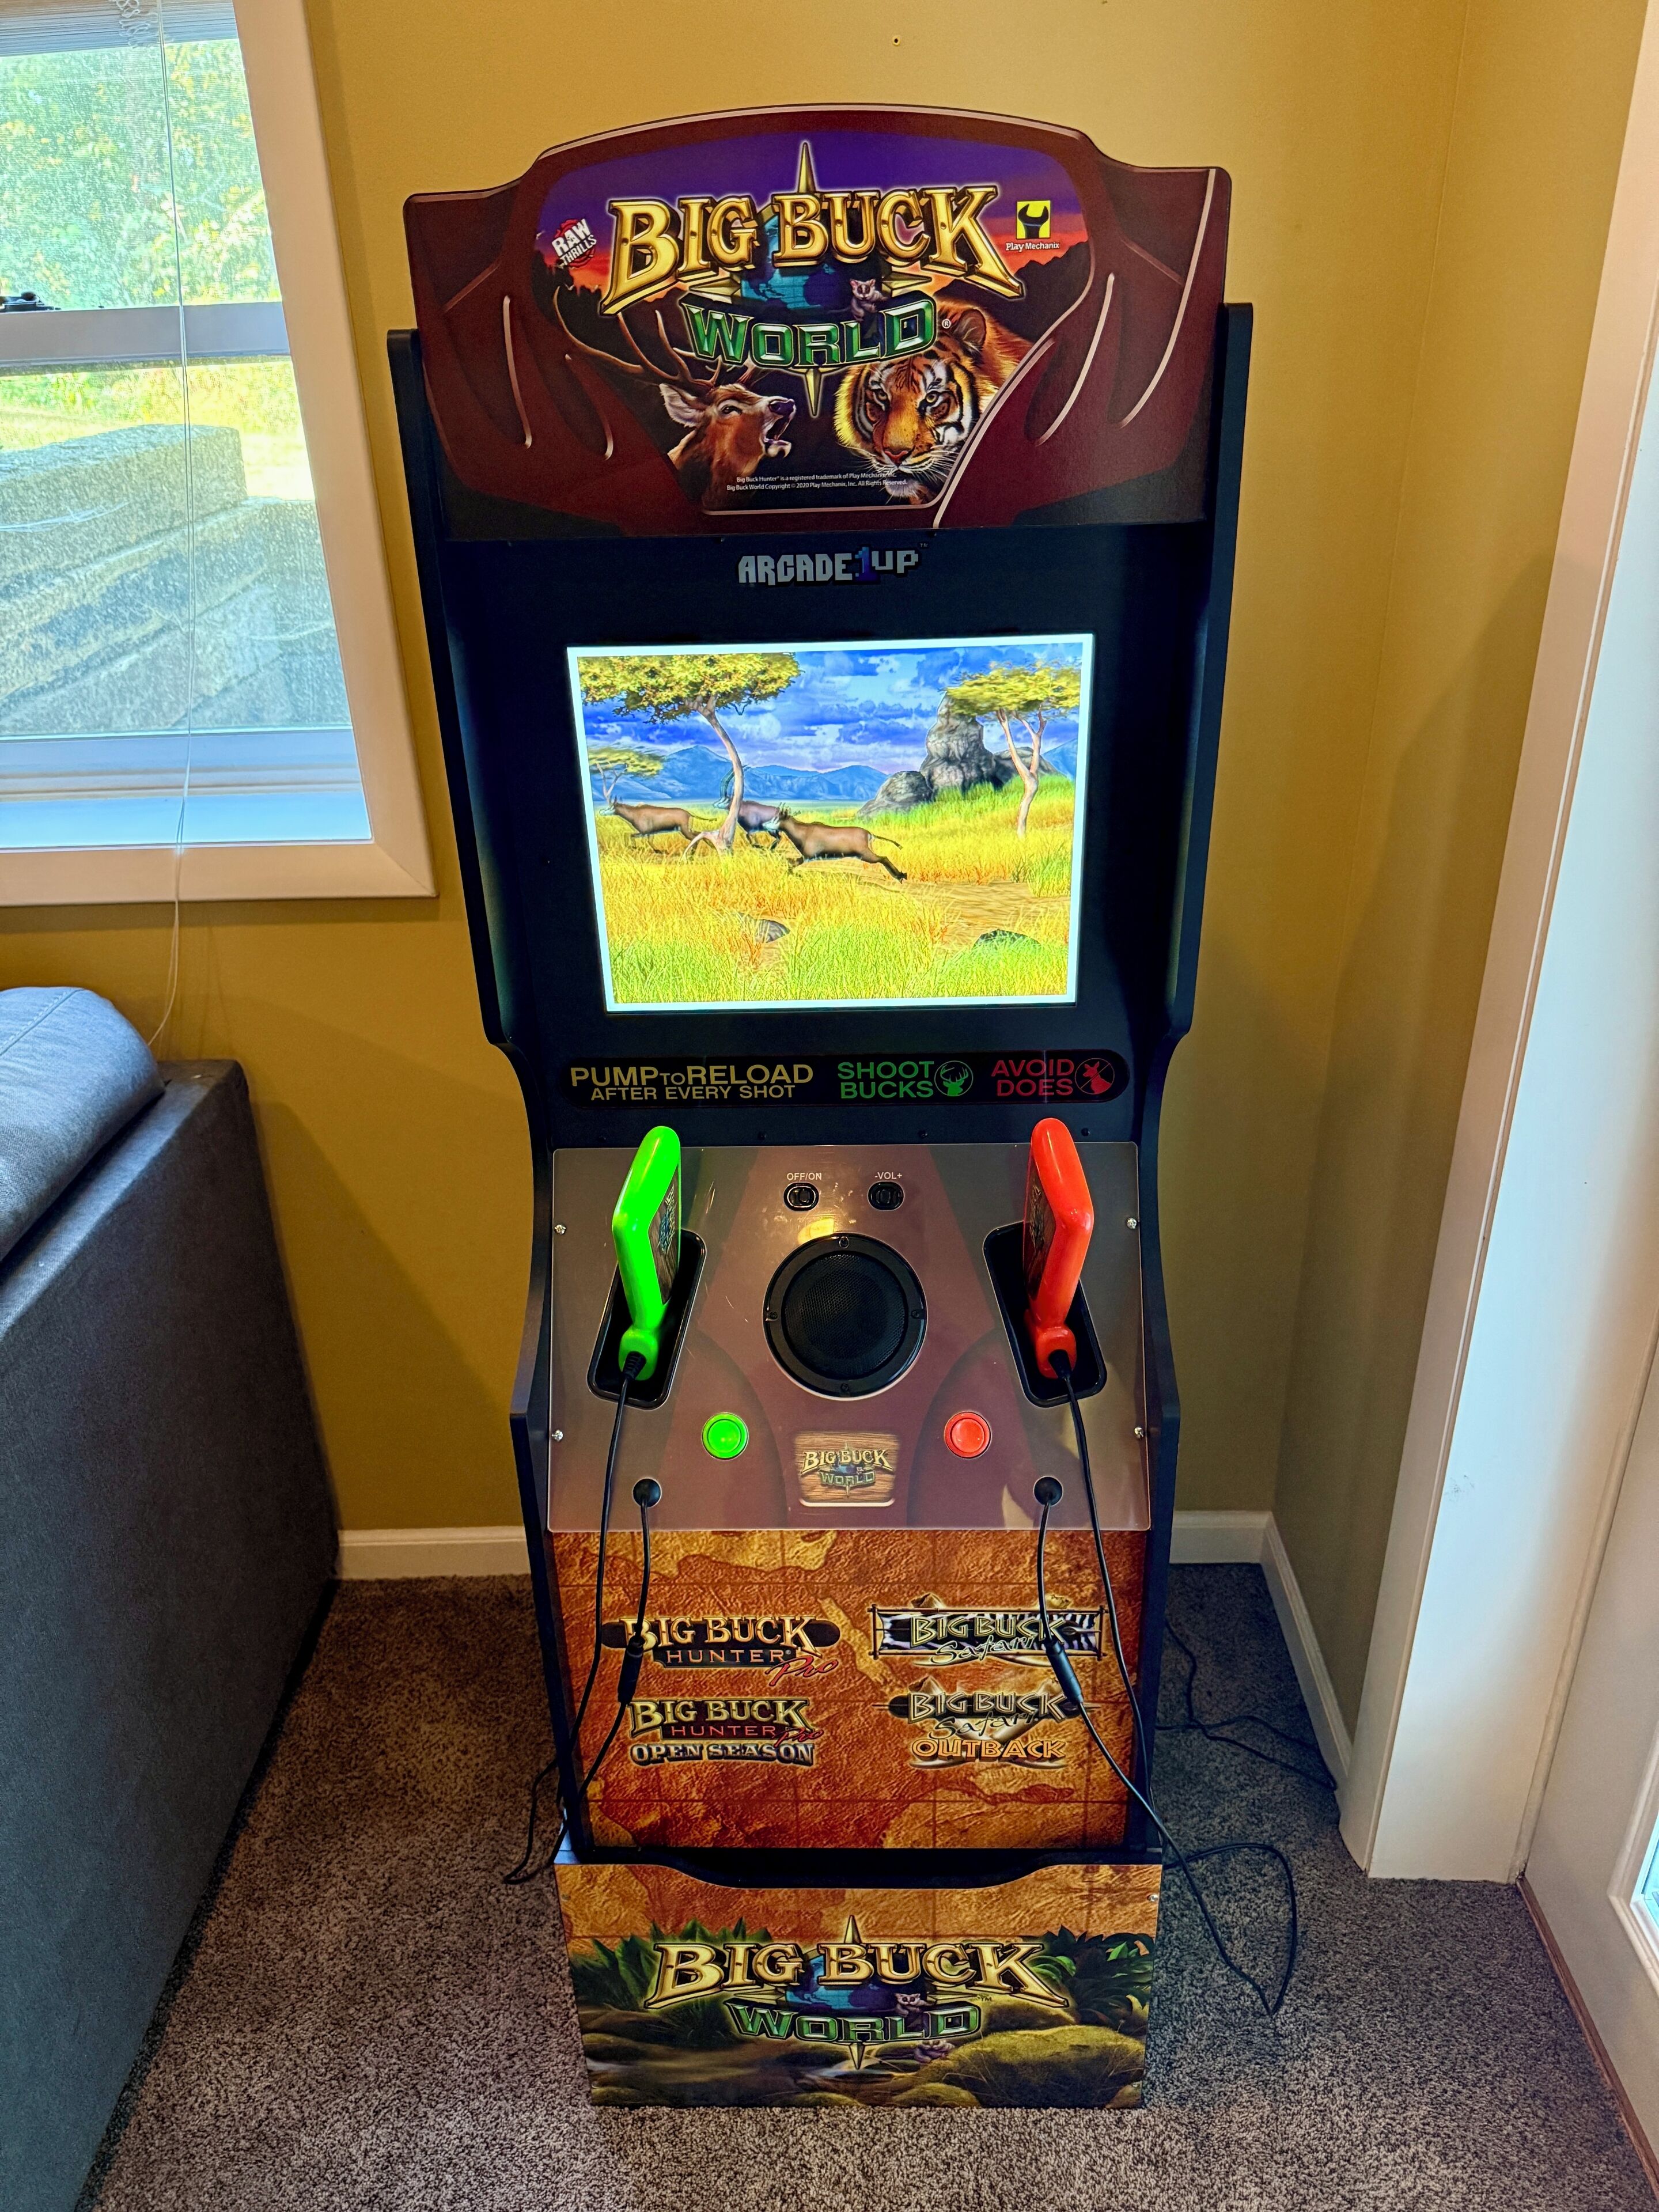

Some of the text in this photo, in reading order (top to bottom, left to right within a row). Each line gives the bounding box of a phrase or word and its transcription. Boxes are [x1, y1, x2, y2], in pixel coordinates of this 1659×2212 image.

[552, 219, 597, 266] RAW THRILLS
[601, 185, 1024, 314] BIG BUCK
[1006, 243, 1024, 252] Play
[681, 297, 936, 368] WORLD
[570, 1064, 813, 1087] PUMP TO RELOAD
[838, 1060, 934, 1080] SHOOT
[991, 1059, 1074, 1077] AVOID
[591, 1085, 796, 1101] AFTER EVERY SHOT
[840, 1081, 934, 1099] BUCKS
[997, 1079, 1073, 1097] DOES
[787, 1172, 822, 1180] OFF/ON
[800, 1449, 895, 1477] BIG BUCK
[820, 1471, 876, 1486] WORLD
[619, 1616, 822, 1658] BIG BUCK
[911, 1615, 1066, 1648] BIG BUCK
[666, 1649, 786, 1664] HUNTER
[930, 1634, 1037, 1664] Safari
[765, 1657, 839, 1687] Pro
[630, 1700, 815, 1738] BIG BUCK
[908, 1692, 1067, 1724] BIG BUCK
[672, 1726, 777, 1736] HUNTER
[928, 1709, 1039, 1740] Safari
[771, 1728, 824, 1747] Pro
[911, 1738, 1066, 1760] OUTBACK
[631, 1743, 815, 1767] OPEN SEASON
[644, 1942, 1070, 2009] BIG BUCK
[725, 2002, 982, 2043] WORLD
